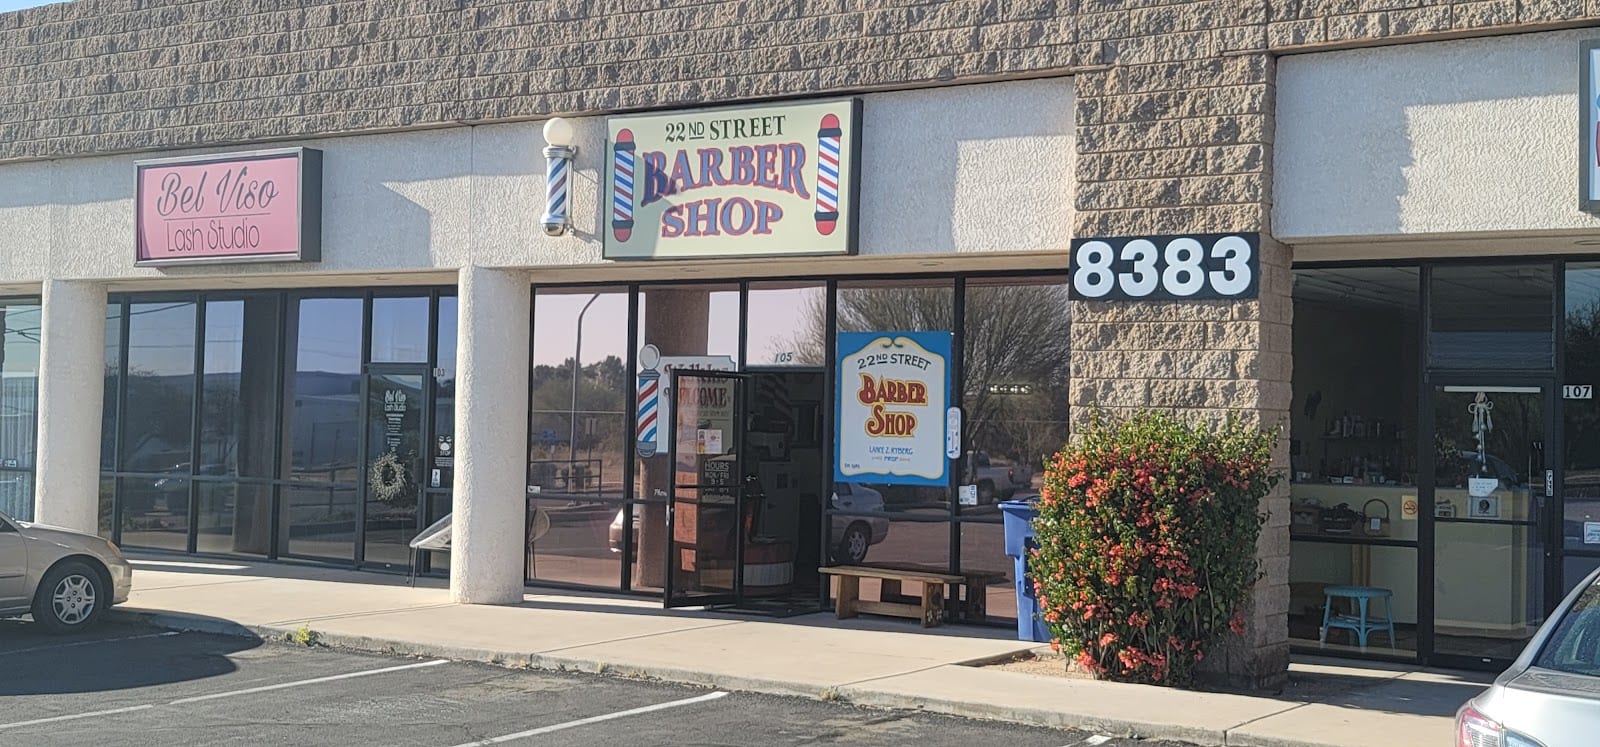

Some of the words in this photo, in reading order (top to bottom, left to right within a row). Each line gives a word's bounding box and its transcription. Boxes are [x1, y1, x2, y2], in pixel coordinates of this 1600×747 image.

[709, 115, 786, 140] STREET
[157, 171, 207, 216] Bel
[216, 166, 279, 213] Viso
[641, 143, 811, 207] BARBER
[661, 197, 783, 238] SHOP
[167, 220, 203, 252] Lash
[207, 217, 260, 250] Studio
[1073, 236, 1252, 297] 8383
[433, 368, 445, 377] 103
[775, 352, 793, 363] 105
[890, 353, 932, 371] STREET
[858, 373, 928, 406] BARBER
[1565, 386, 1590, 398] 107
[865, 403, 918, 438] SHOP
[704, 461, 729, 471] HOURS
